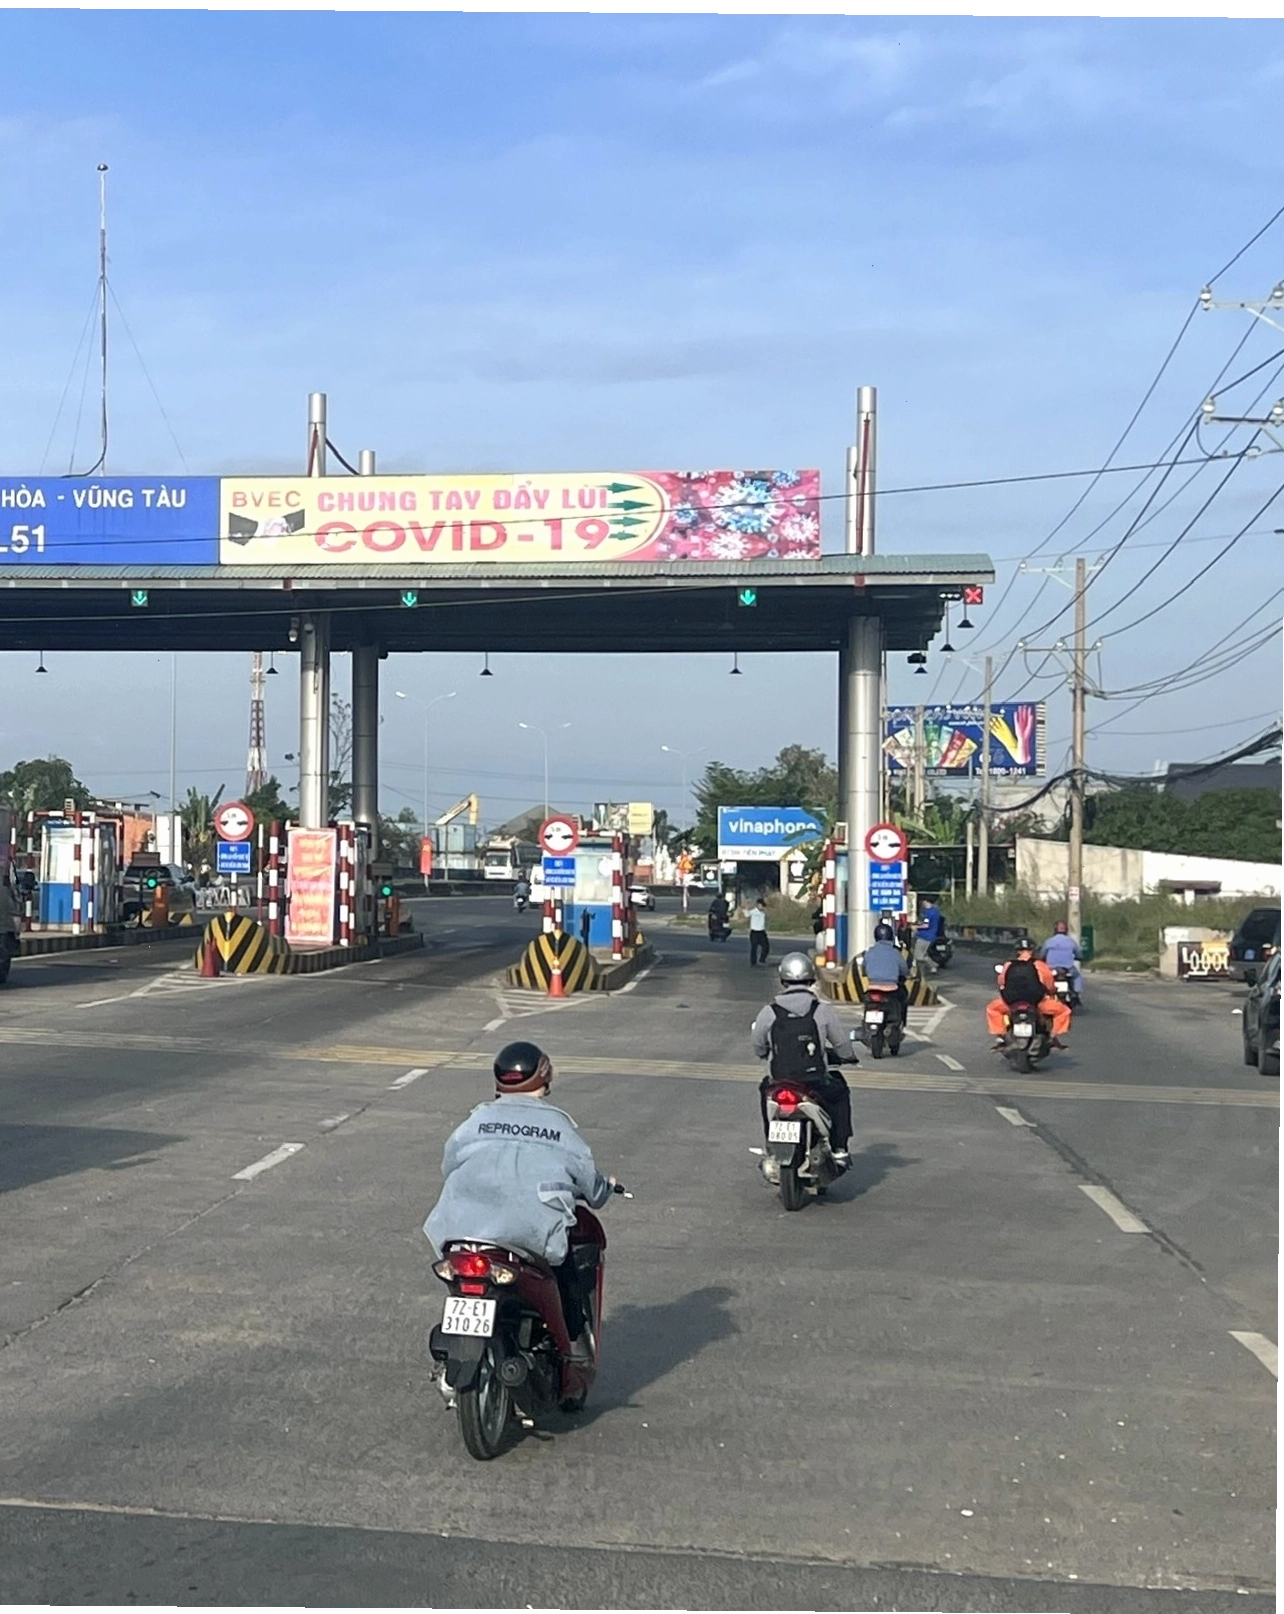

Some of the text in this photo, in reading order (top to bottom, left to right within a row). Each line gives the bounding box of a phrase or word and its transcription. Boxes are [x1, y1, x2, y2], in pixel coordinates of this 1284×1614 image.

[1, 483, 46, 508] HÒA
[72, 485, 134, 508] VŨNG
[141, 484, 186, 508] TÀU
[232, 490, 301, 508] BVEC
[317, 491, 417, 512] CHUNG
[429, 489, 481, 511] TAY
[314, 517, 610, 553] COVID-19
[478, 1122, 561, 1142] REPROGRAM
[451, 1299, 487, 1317] 72-E1
